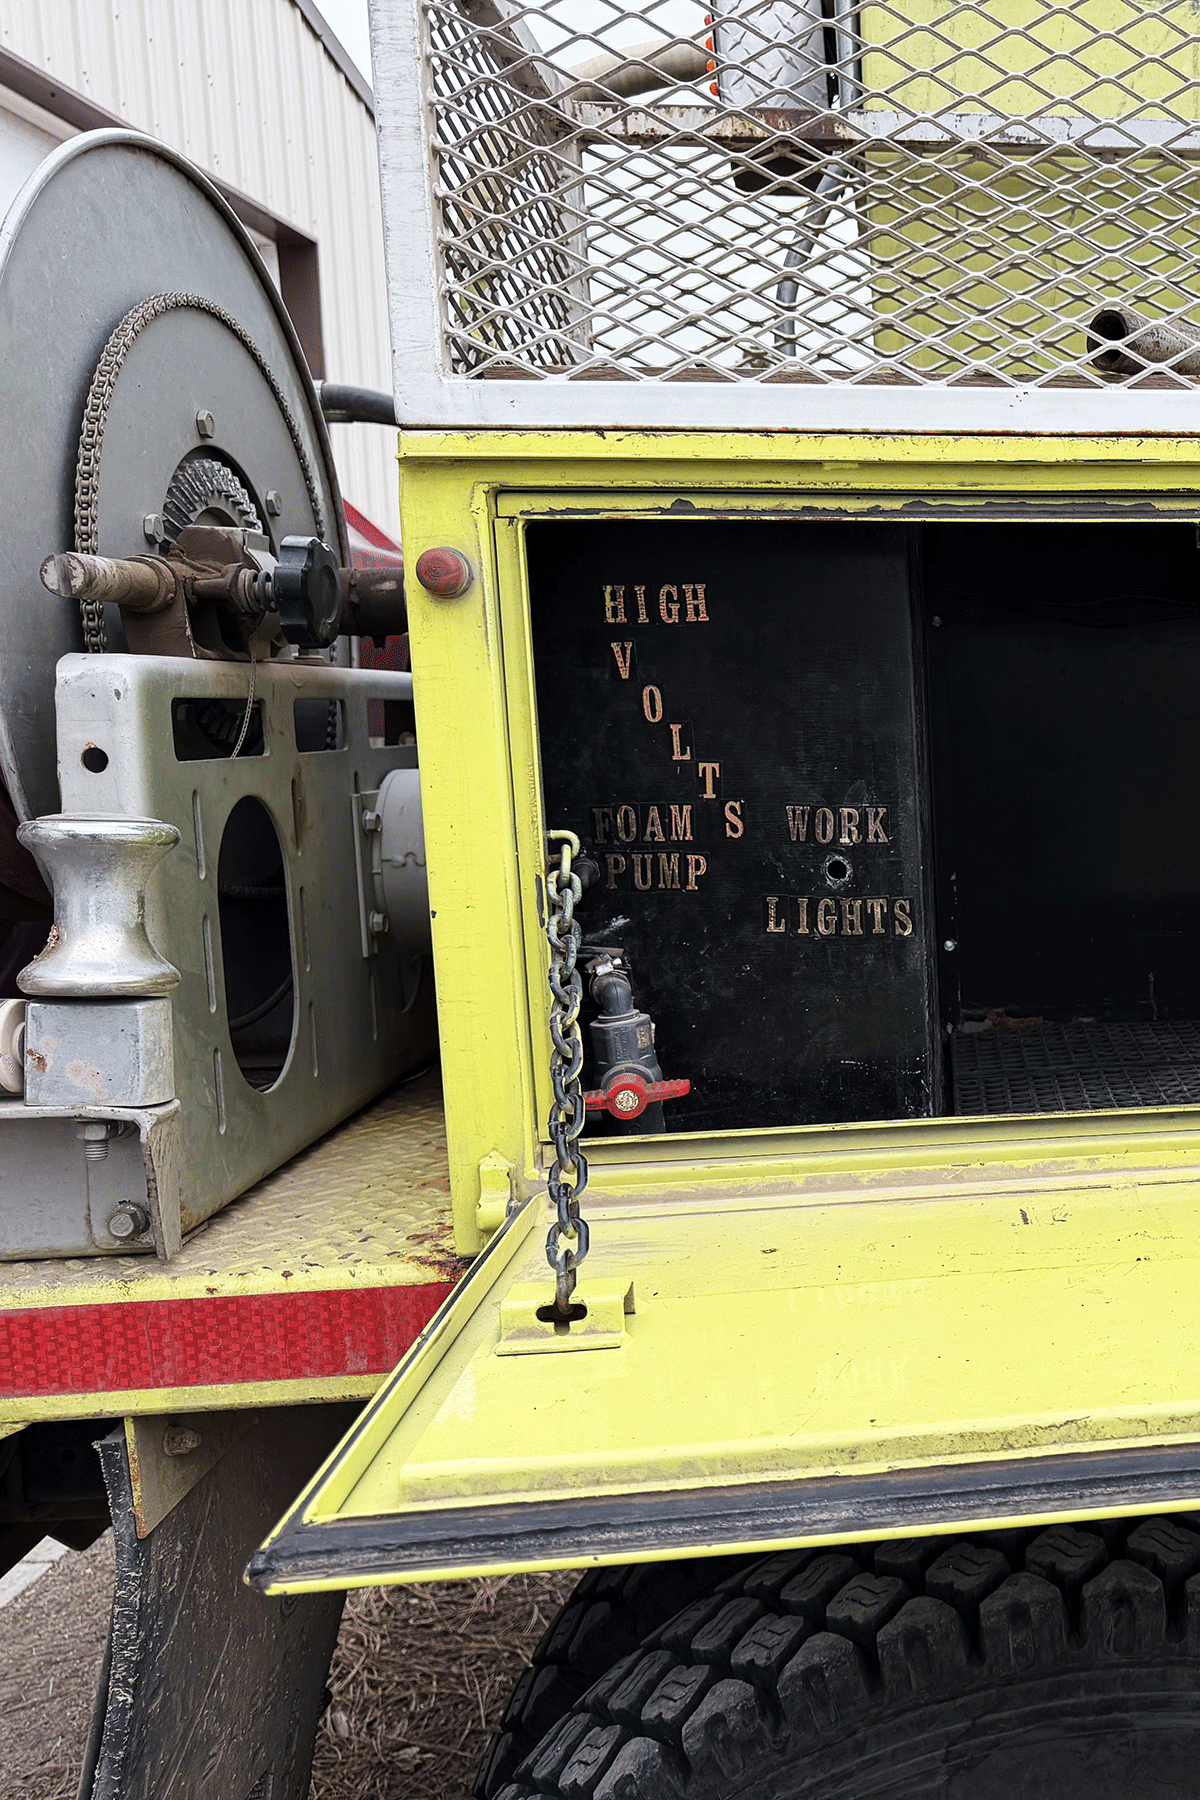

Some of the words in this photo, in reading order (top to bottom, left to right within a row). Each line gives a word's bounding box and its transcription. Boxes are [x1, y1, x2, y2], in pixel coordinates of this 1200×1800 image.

[604, 583, 710, 624] HIGH
[592, 803, 694, 844] FOAM
[785, 805, 890, 844] WORK
[605, 853, 708, 891] PUMP
[766, 896, 913, 937] LIGHTS
